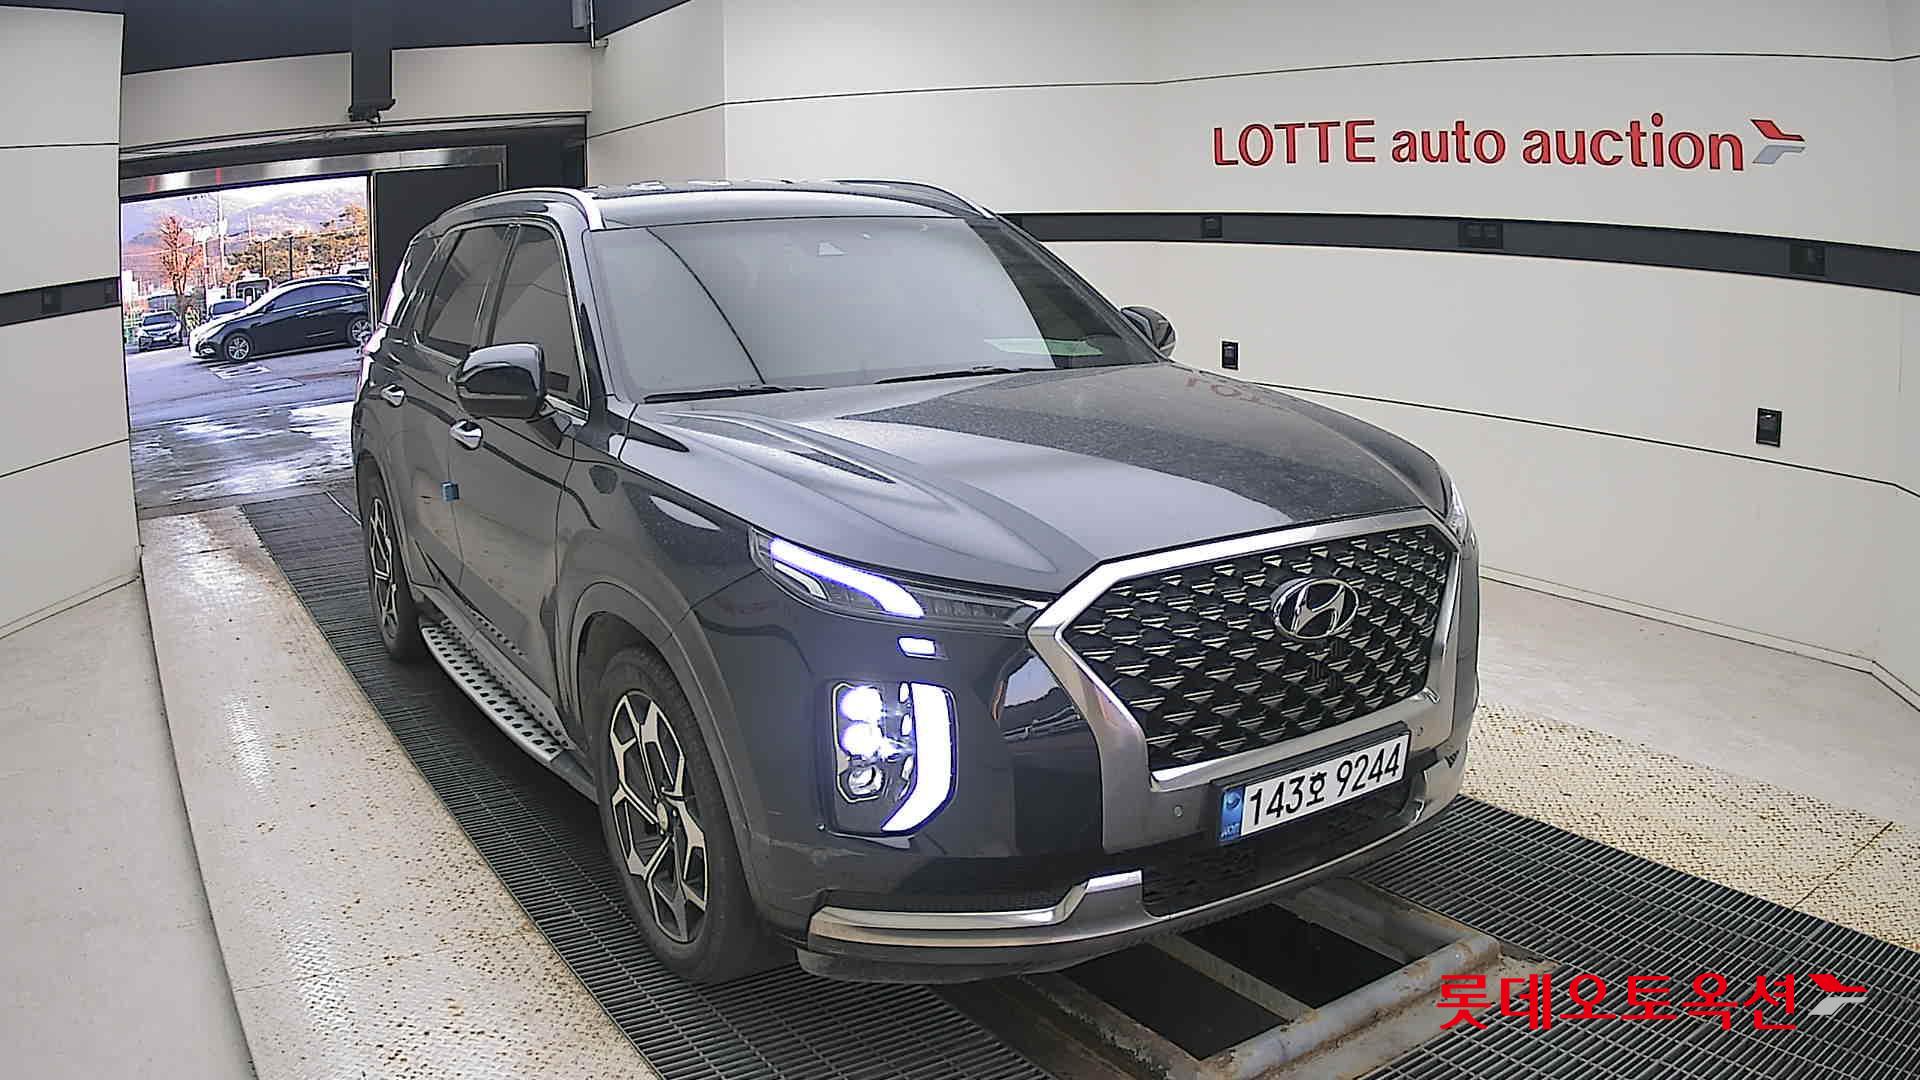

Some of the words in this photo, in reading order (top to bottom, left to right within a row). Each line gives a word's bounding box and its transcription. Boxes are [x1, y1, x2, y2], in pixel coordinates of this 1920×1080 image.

[1213, 120, 1376, 166] LOTTE
[1391, 120, 1506, 164] auto
[1521, 112, 1744, 171] auction
[1250, 771, 1327, 825] 143호
[1336, 743, 1401, 798] 9244
